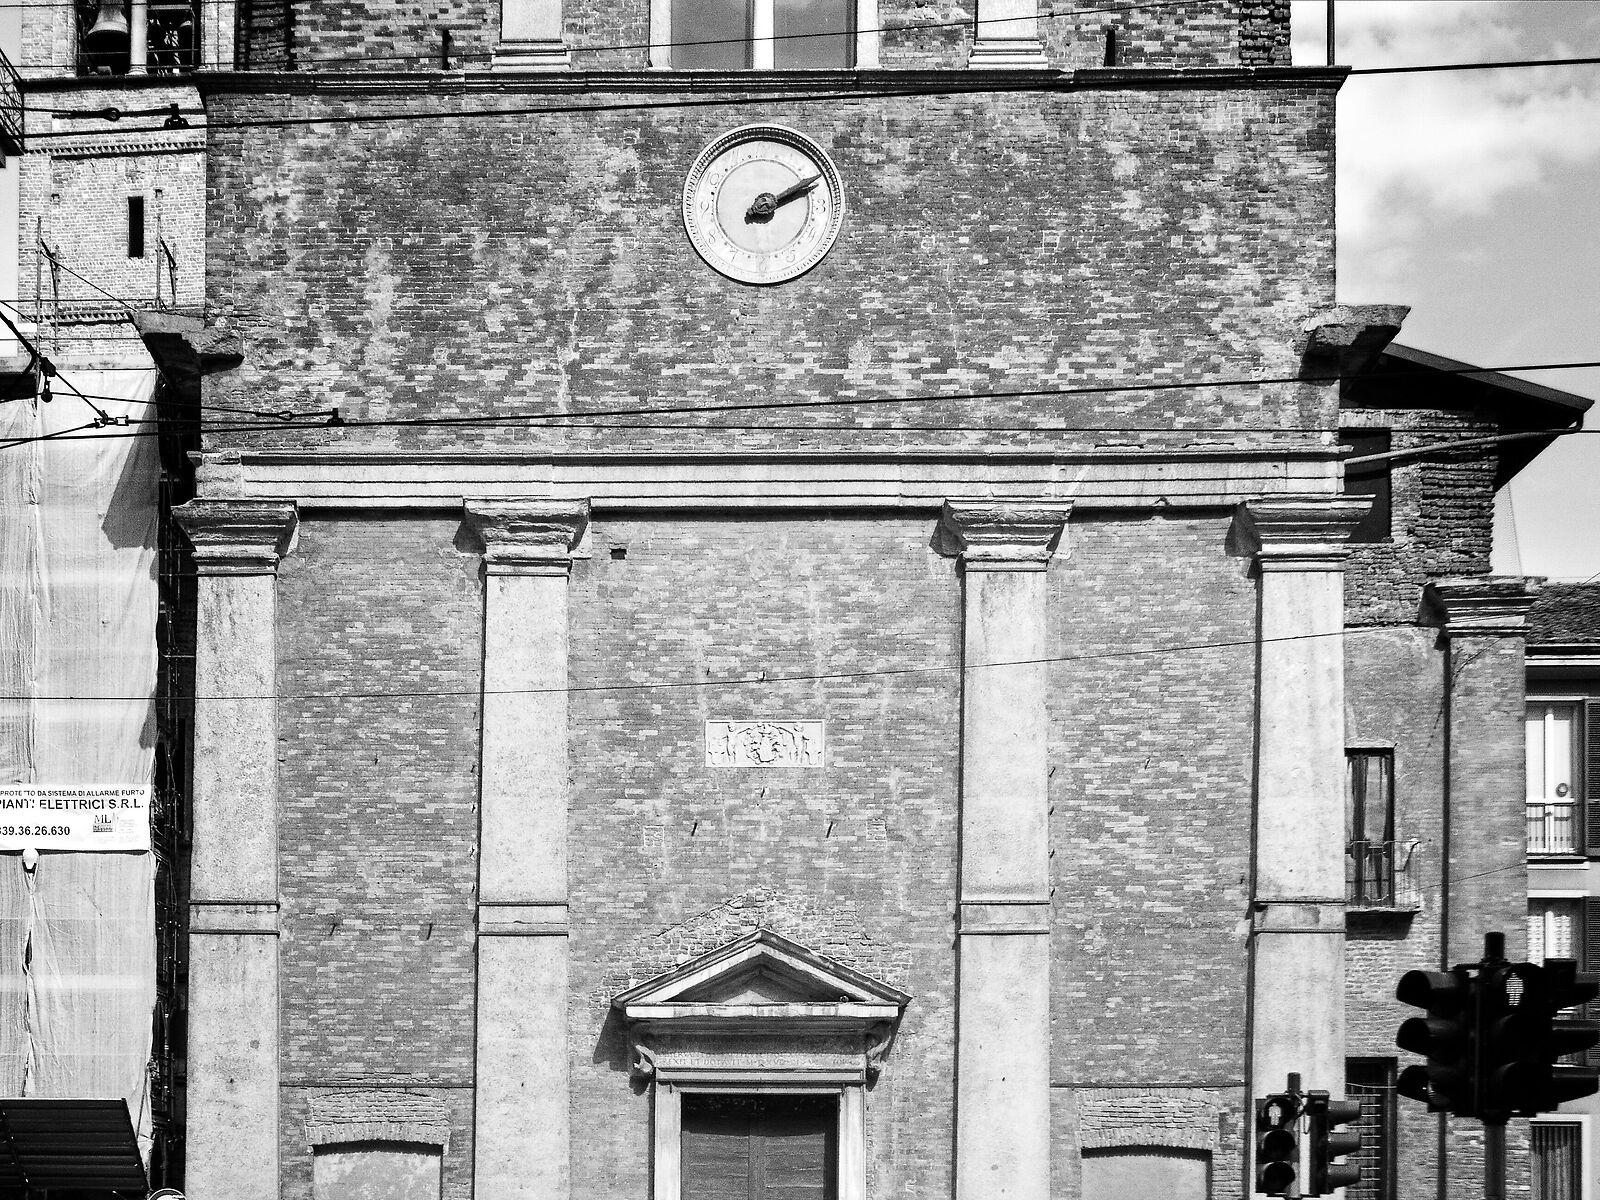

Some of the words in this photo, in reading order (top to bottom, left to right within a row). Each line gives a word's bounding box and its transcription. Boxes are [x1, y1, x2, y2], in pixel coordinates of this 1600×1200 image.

[815, 199, 827, 214] 3
[39, 799, 105, 810] ELETTRICI
[108, 798, 144, 810] S.R.L.
[0, 825, 70, 836] 39.36.26.630
